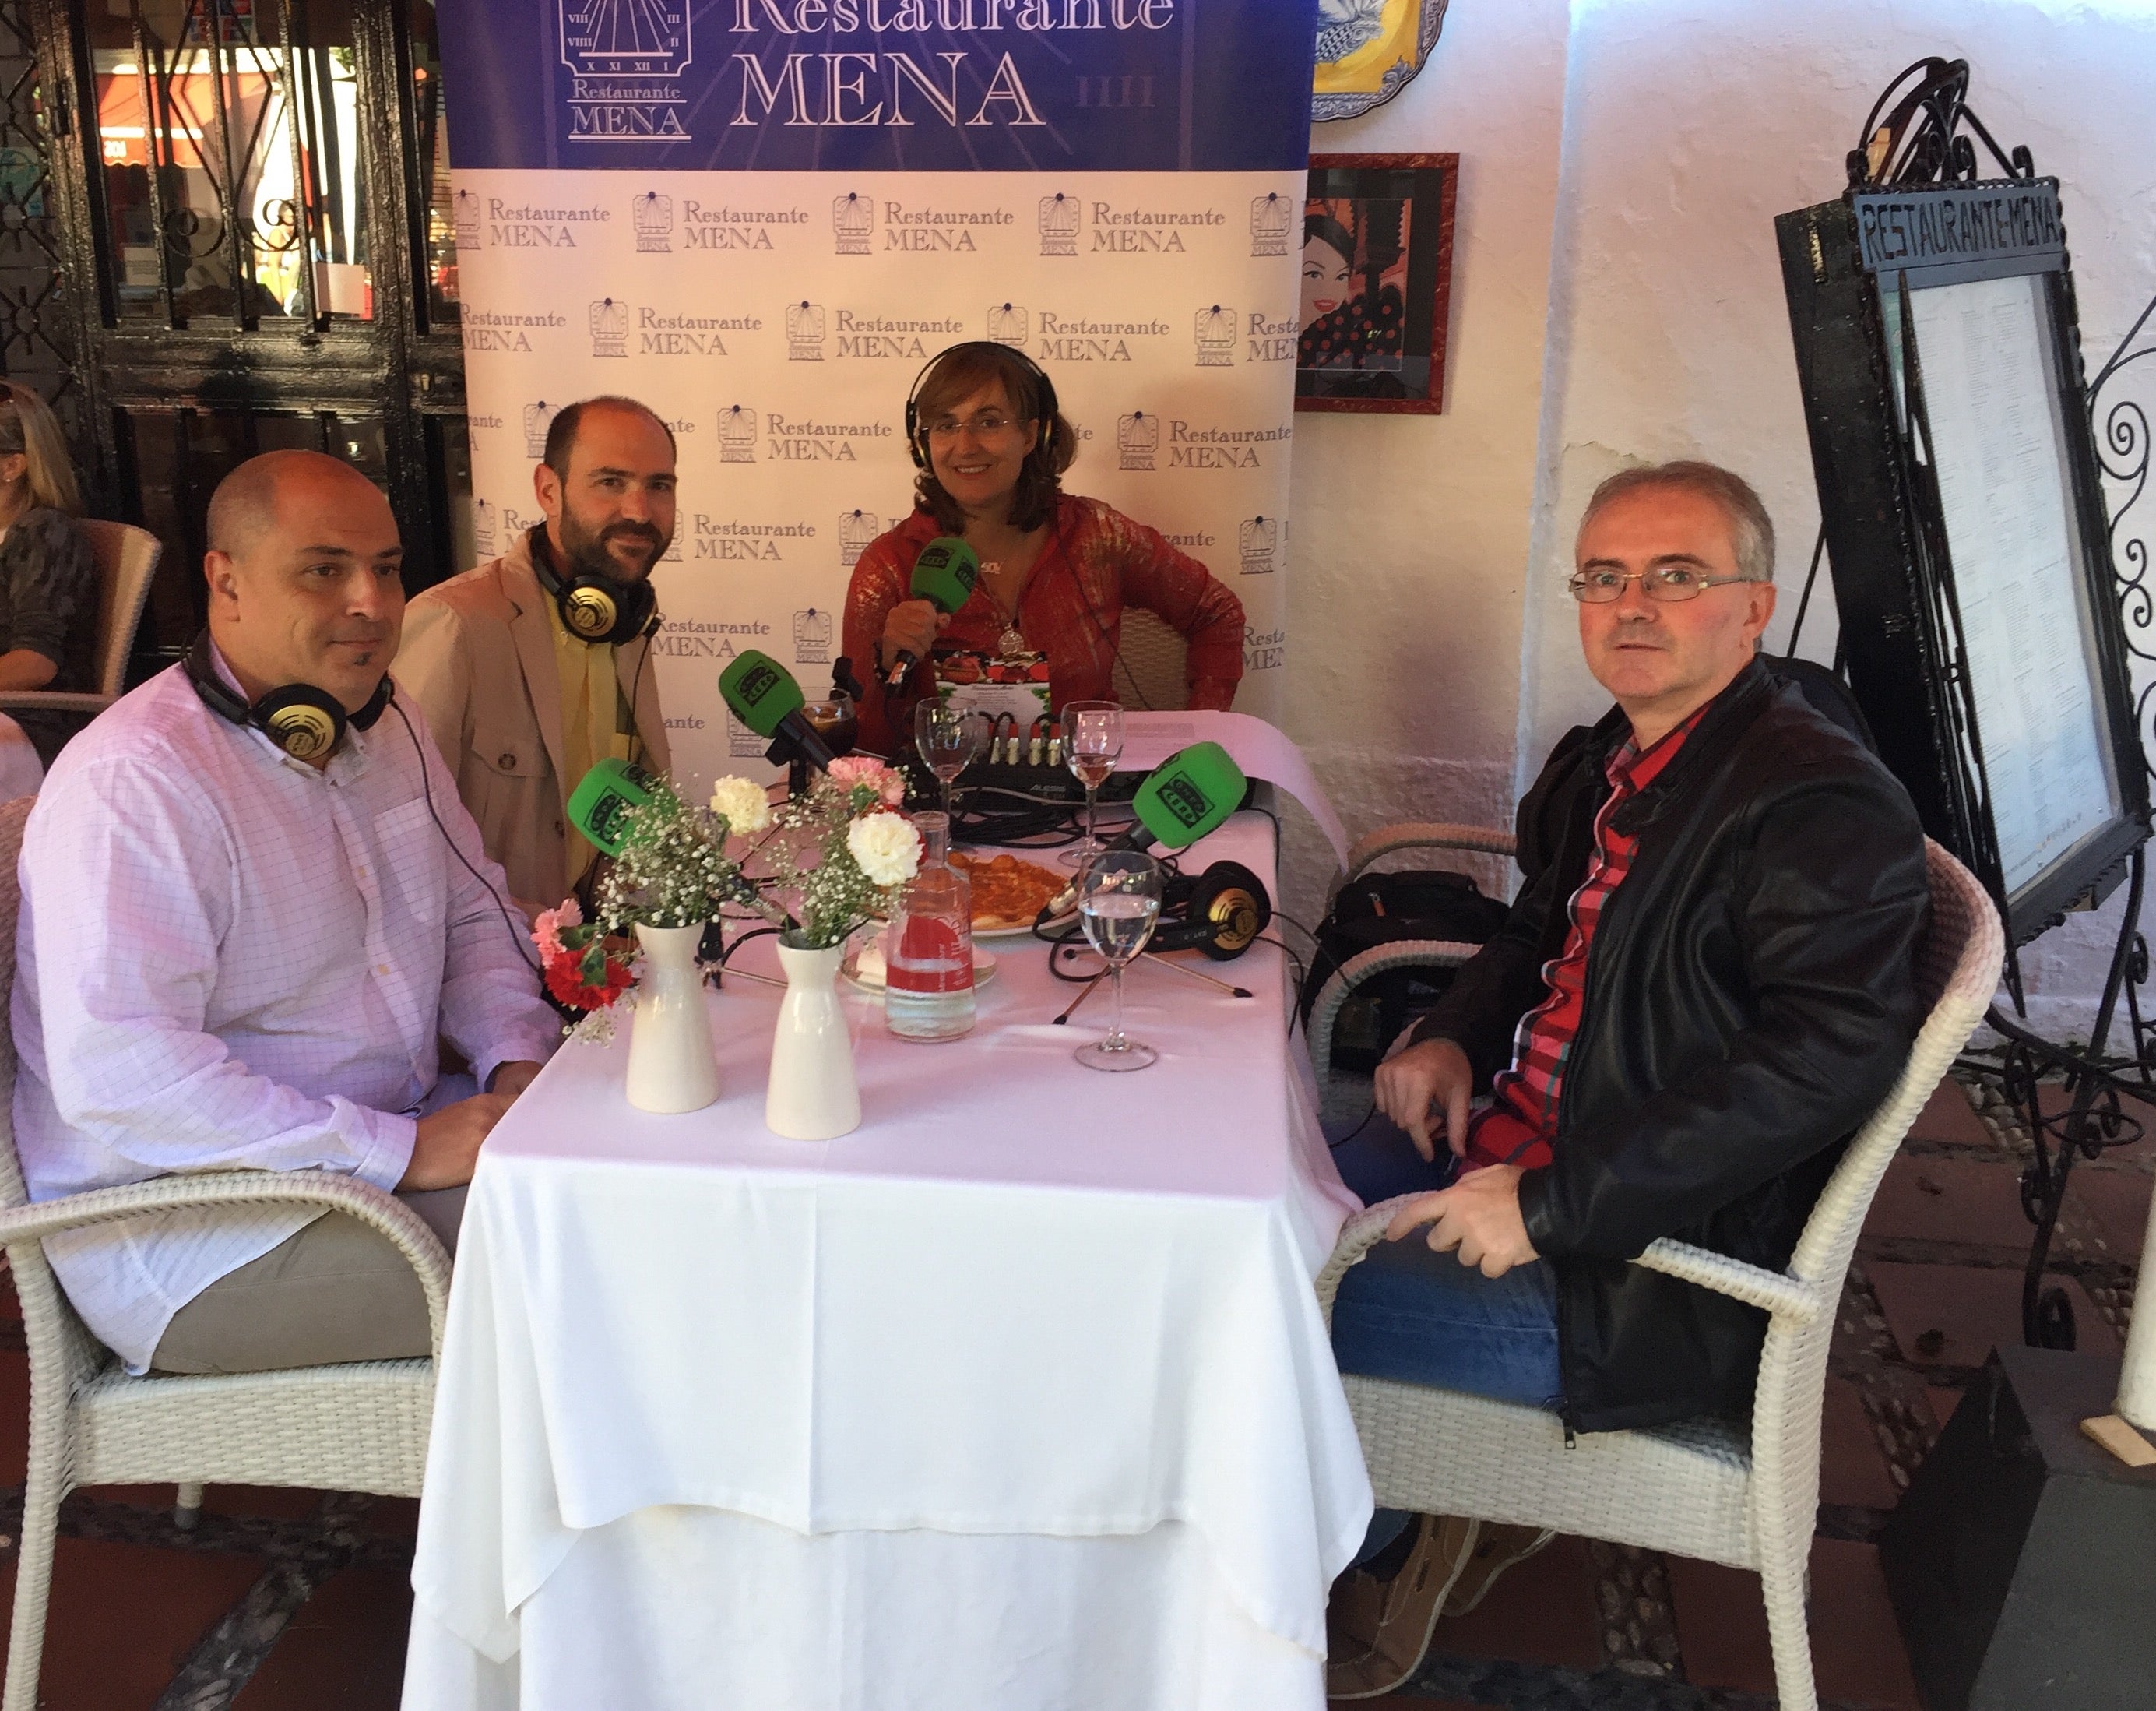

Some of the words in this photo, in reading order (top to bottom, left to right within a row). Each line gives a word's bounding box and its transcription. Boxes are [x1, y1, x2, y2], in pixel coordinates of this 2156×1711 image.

[568, 14, 589, 24] VIII
[666, 14, 681, 24] III
[729, 0, 1174, 33] Restaurante
[670, 37, 680, 48] II
[586, 62, 596, 72] X
[609, 62, 621, 72] XI
[634, 62, 651, 72] XII
[572, 79, 681, 100] Restaurante
[730, 51, 1047, 127] MENA
[571, 106, 687, 135] MENA
[488, 199, 611, 222] Restaurante
[683, 200, 809, 224] Restaurante
[884, 202, 1014, 225] Restaurante
[1092, 202, 1226, 227] Restaurante
[490, 224, 577, 248] MENA
[683, 227, 774, 250] MENA
[884, 229, 977, 252] MENA
[1091, 230, 1186, 253] MENA
[638, 307, 762, 331] Restaurante
[835, 310, 963, 334] Restaurante
[1039, 312, 1170, 337] Restaurante
[639, 333, 728, 356] MENA
[835, 336, 929, 359] MENA
[1039, 340, 1132, 362] MENA
[767, 414, 892, 437] Restaurante
[1169, 421, 1292, 444] Restaurante
[768, 440, 856, 461] MENA
[1168, 446, 1261, 468] MENA
[694, 514, 816, 537] Restaurante
[694, 540, 783, 561] MENA
[652, 635, 737, 658] MENA
